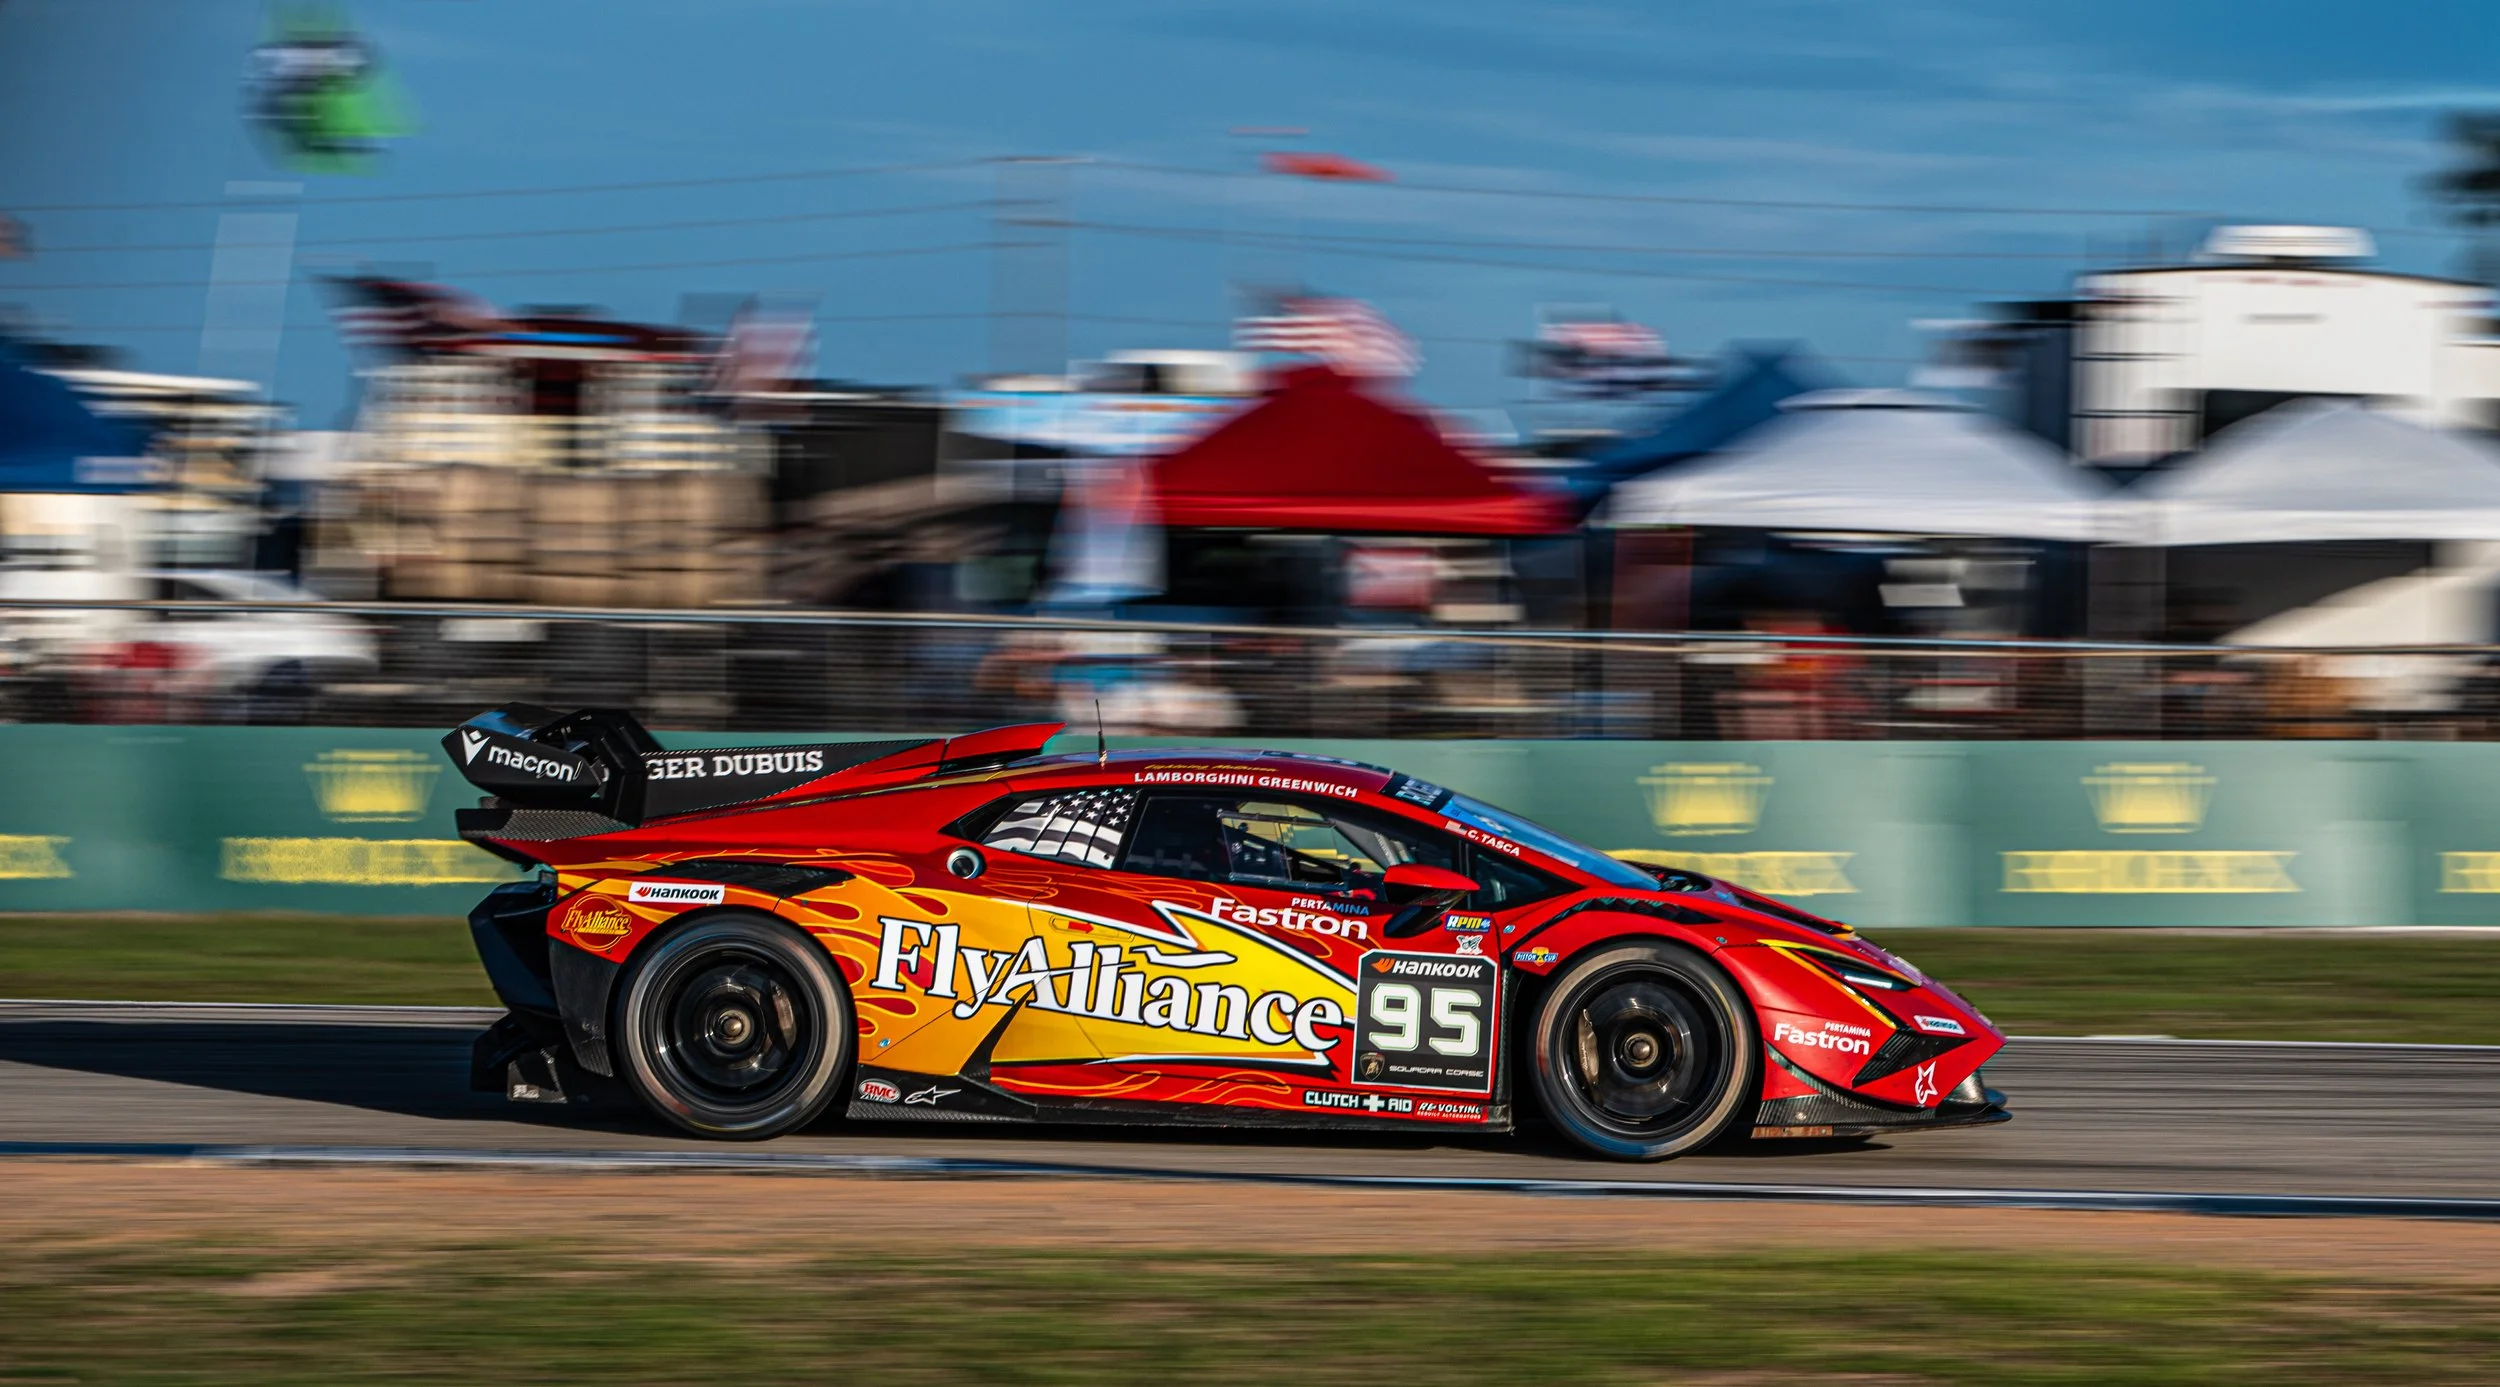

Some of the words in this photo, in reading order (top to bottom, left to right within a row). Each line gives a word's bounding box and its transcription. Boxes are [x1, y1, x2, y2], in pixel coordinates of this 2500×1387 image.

[488, 746, 574, 782] macron
[646, 757, 707, 780] GER
[712, 751, 824, 777] DUBUIS
[1134, 772, 1254, 786] LAMBORGHINI
[1258, 776, 1358, 798] GREENWICH
[1480, 834, 1520, 857] TASCA
[1210, 896, 1368, 940] Fastron
[1292, 897, 1370, 916] PERTAMINA
[1446, 915, 1483, 929] RPM
[872, 916, 1344, 1050] FlyAlliance
[1368, 982, 1482, 1056] 95
[1824, 1021, 1871, 1037] PERTAMINA
[1774, 1022, 1870, 1056] Fastron
[1389, 1065, 1442, 1075] SQUADRA
[1445, 1068, 1484, 1078] CORSE
[863, 1083, 897, 1099] BMC
[1305, 1091, 1359, 1108] CLUTCH
[1388, 1098, 1412, 1112] AID
